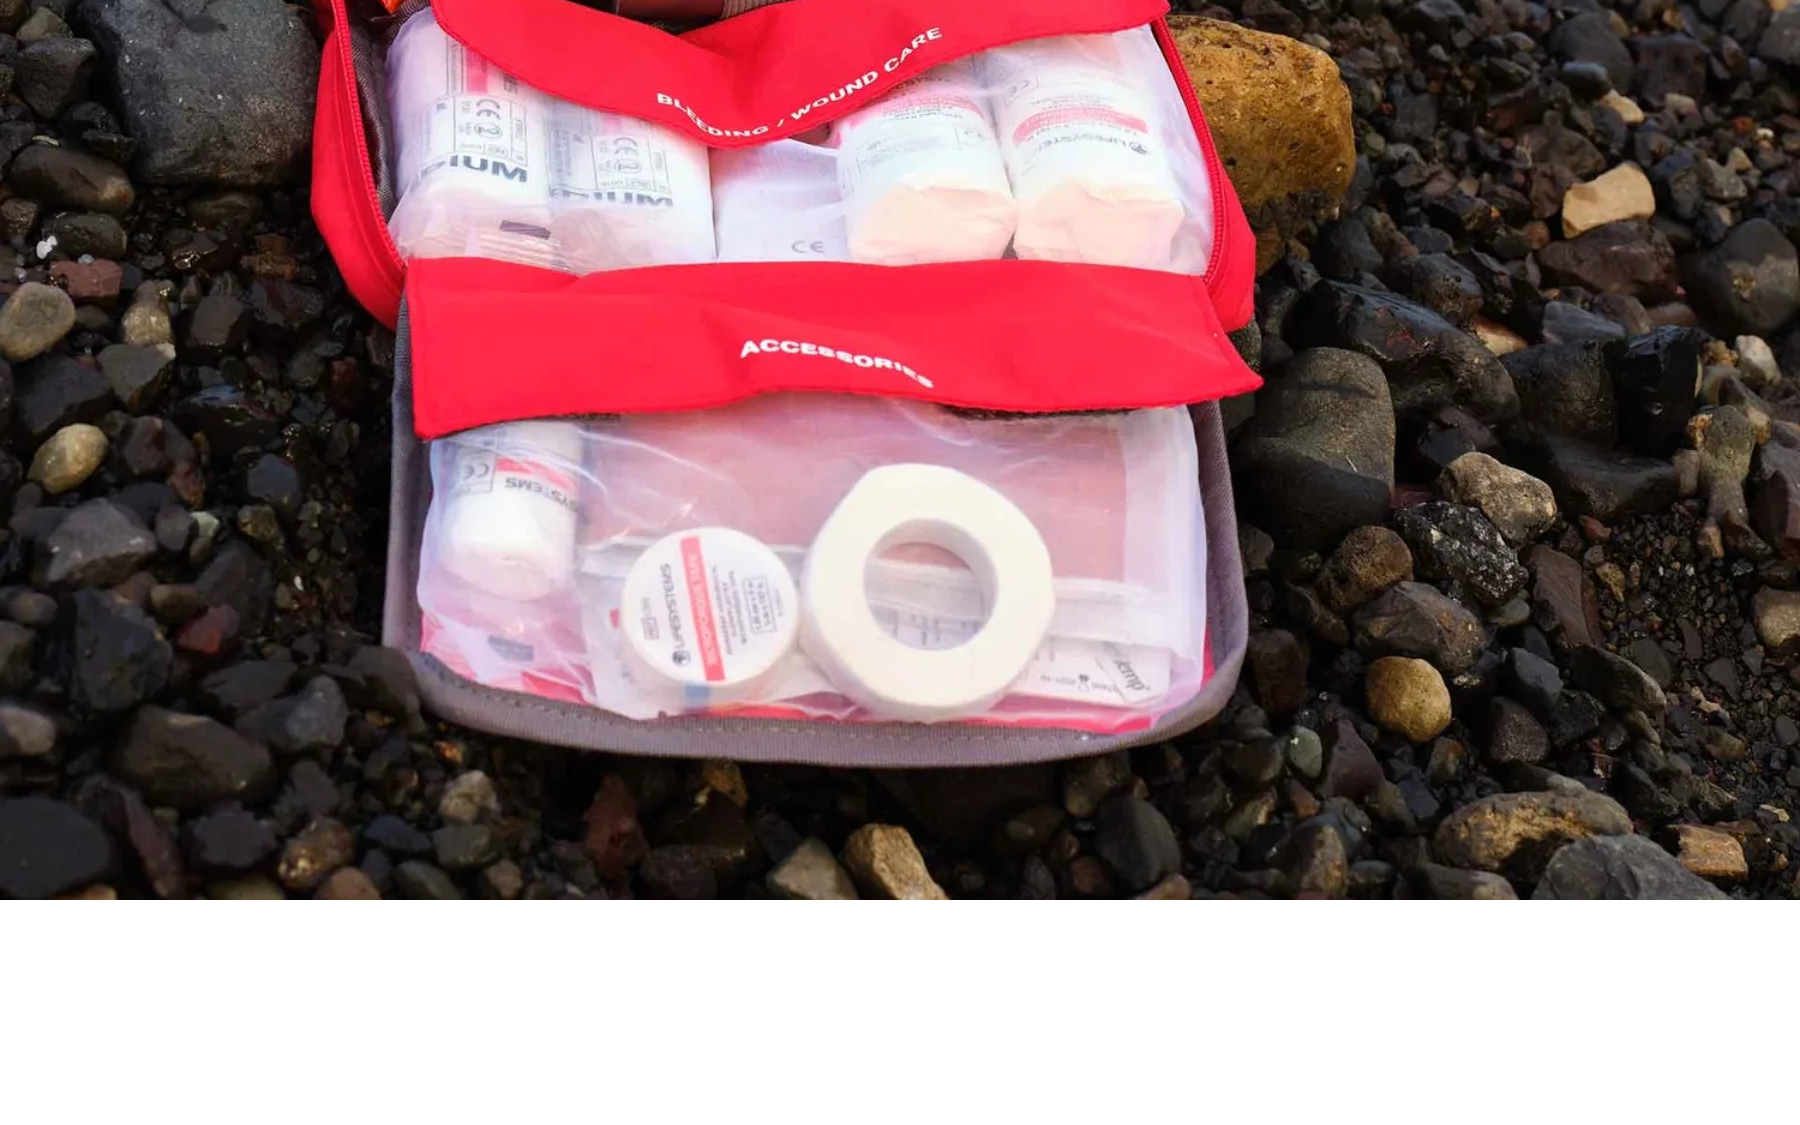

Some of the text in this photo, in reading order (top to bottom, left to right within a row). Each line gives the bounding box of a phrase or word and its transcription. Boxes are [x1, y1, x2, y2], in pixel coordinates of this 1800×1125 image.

[656, 27, 943, 138] BLEEDING / WOUND CARE
[740, 338, 934, 389] ACCESSORIES
